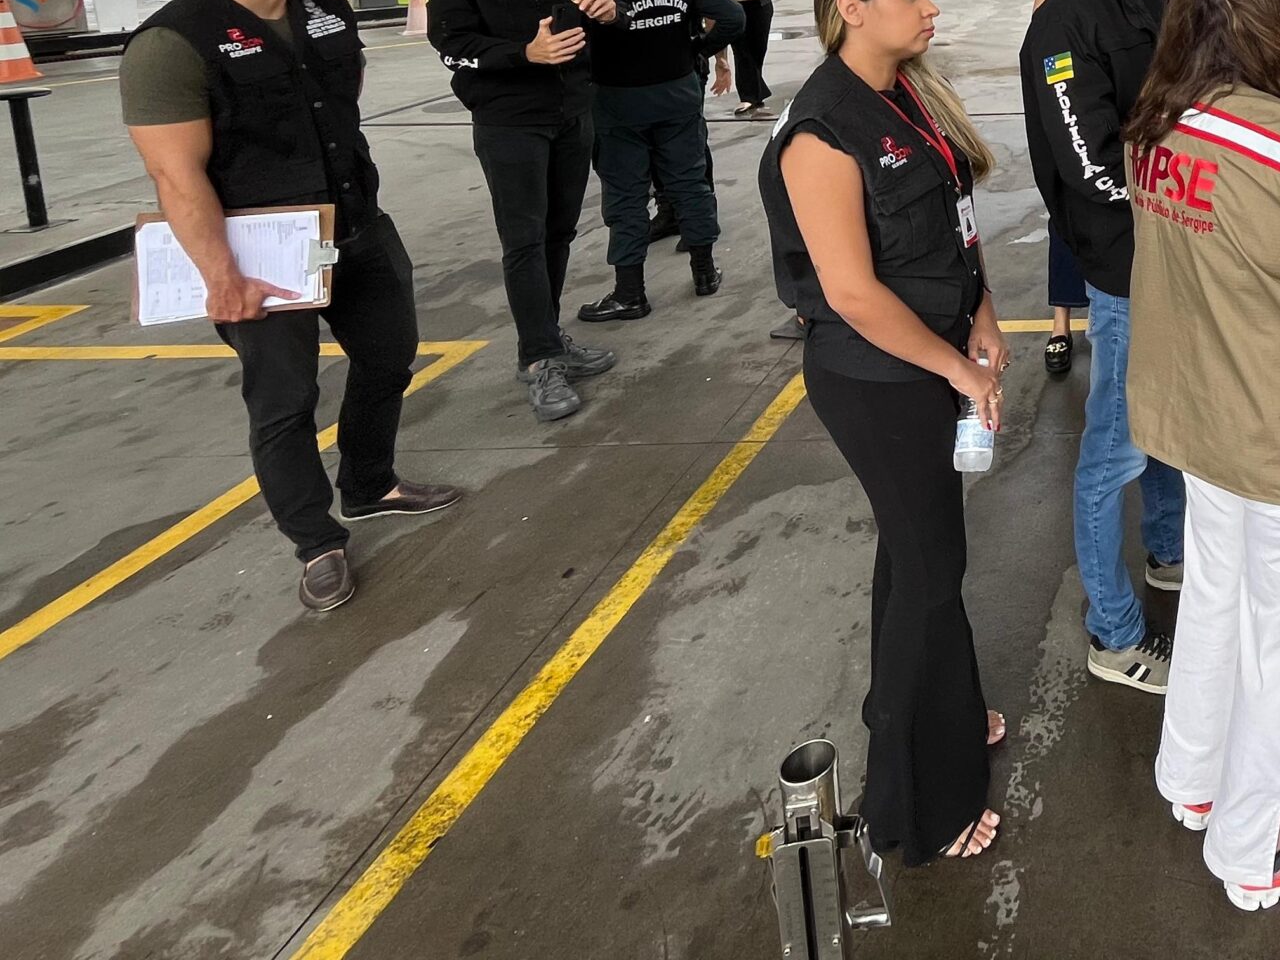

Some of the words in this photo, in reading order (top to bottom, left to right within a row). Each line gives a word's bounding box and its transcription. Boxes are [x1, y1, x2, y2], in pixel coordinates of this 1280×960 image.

[629, 12, 682, 30] SERGIPE
[218, 37, 264, 53] PROCON
[1131, 143, 1219, 212] MPSE
[1181, 210, 1214, 235] Sergipe
